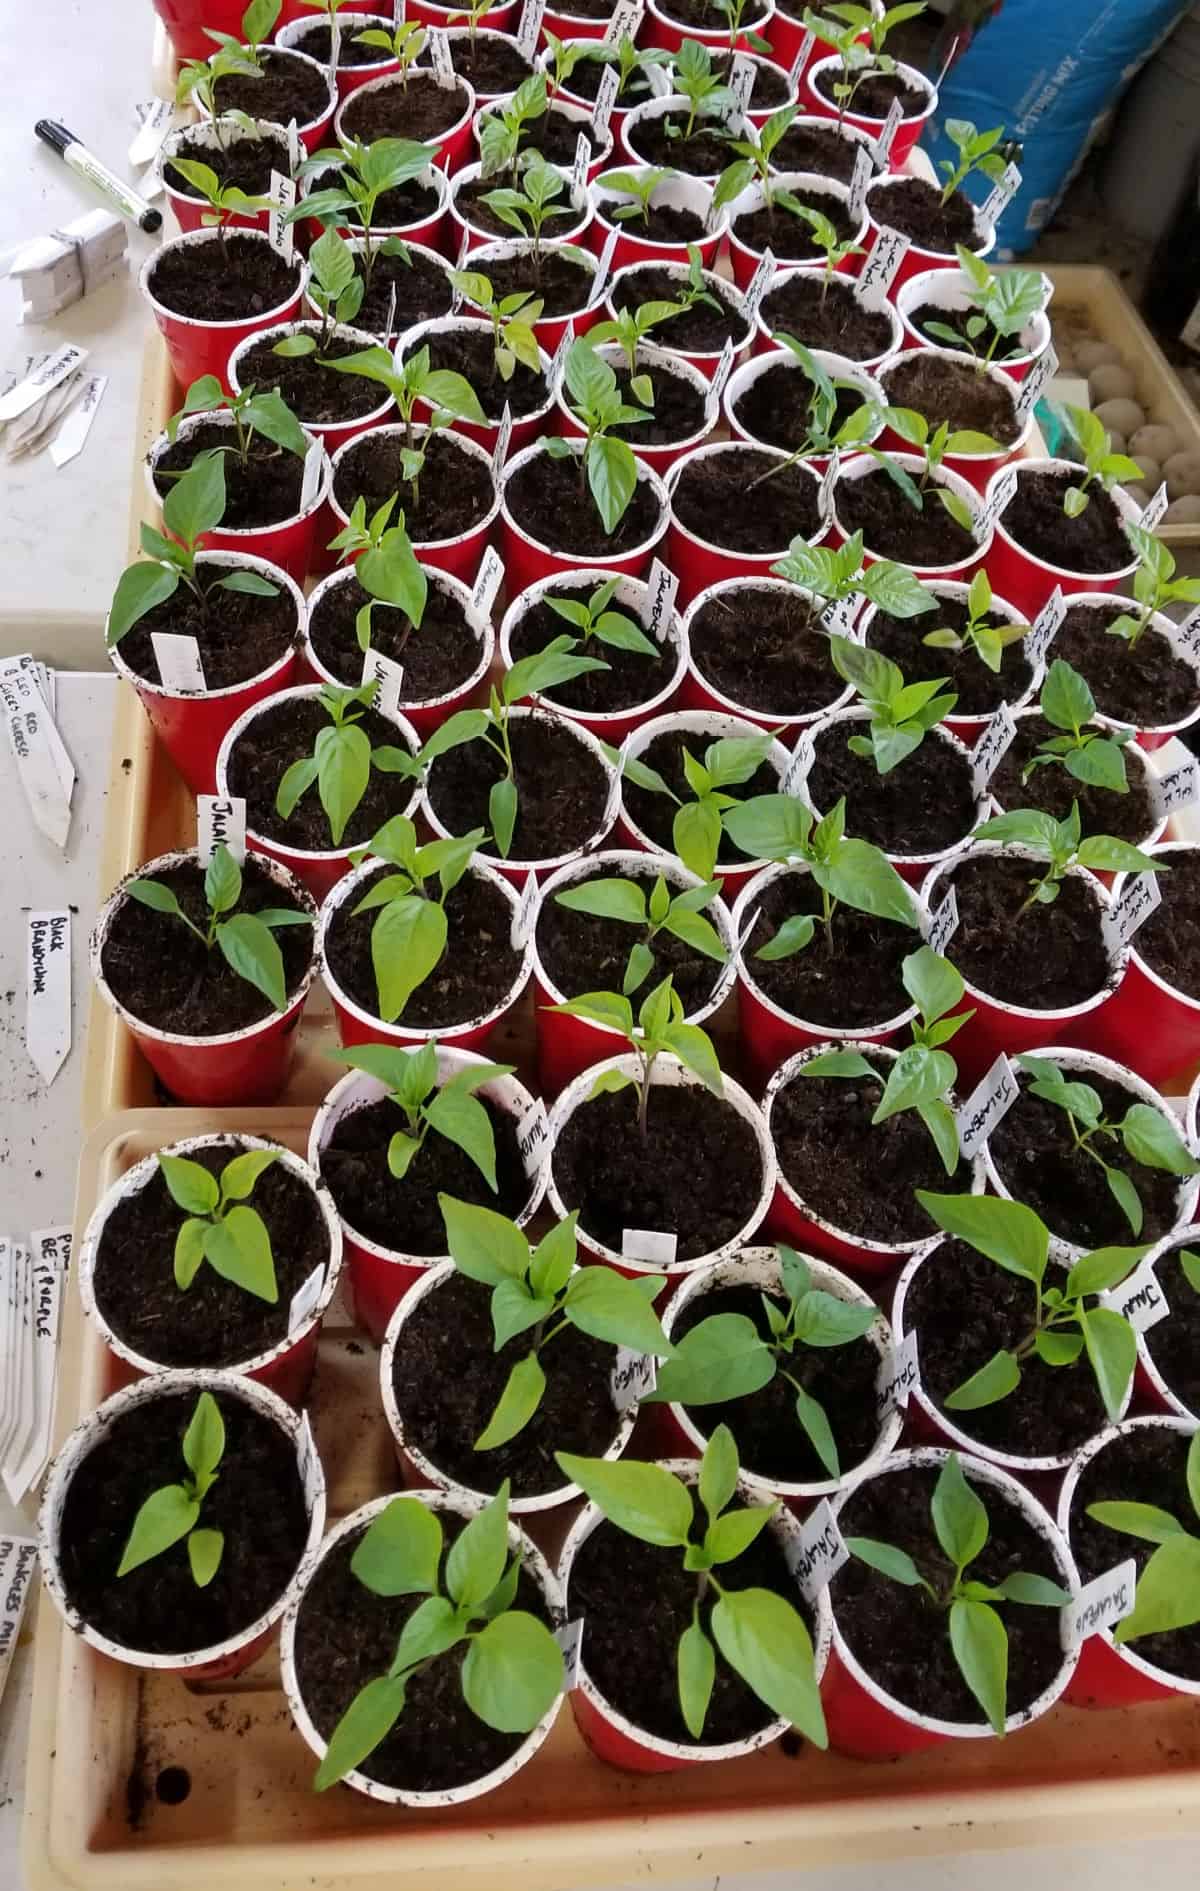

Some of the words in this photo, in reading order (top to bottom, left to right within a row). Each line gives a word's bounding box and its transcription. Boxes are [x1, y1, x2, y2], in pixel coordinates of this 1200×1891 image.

[25, 711, 39, 735] RED
[963, 1076, 1013, 1143] JALAPENO
[36, 1276, 56, 1338] PURPLE
